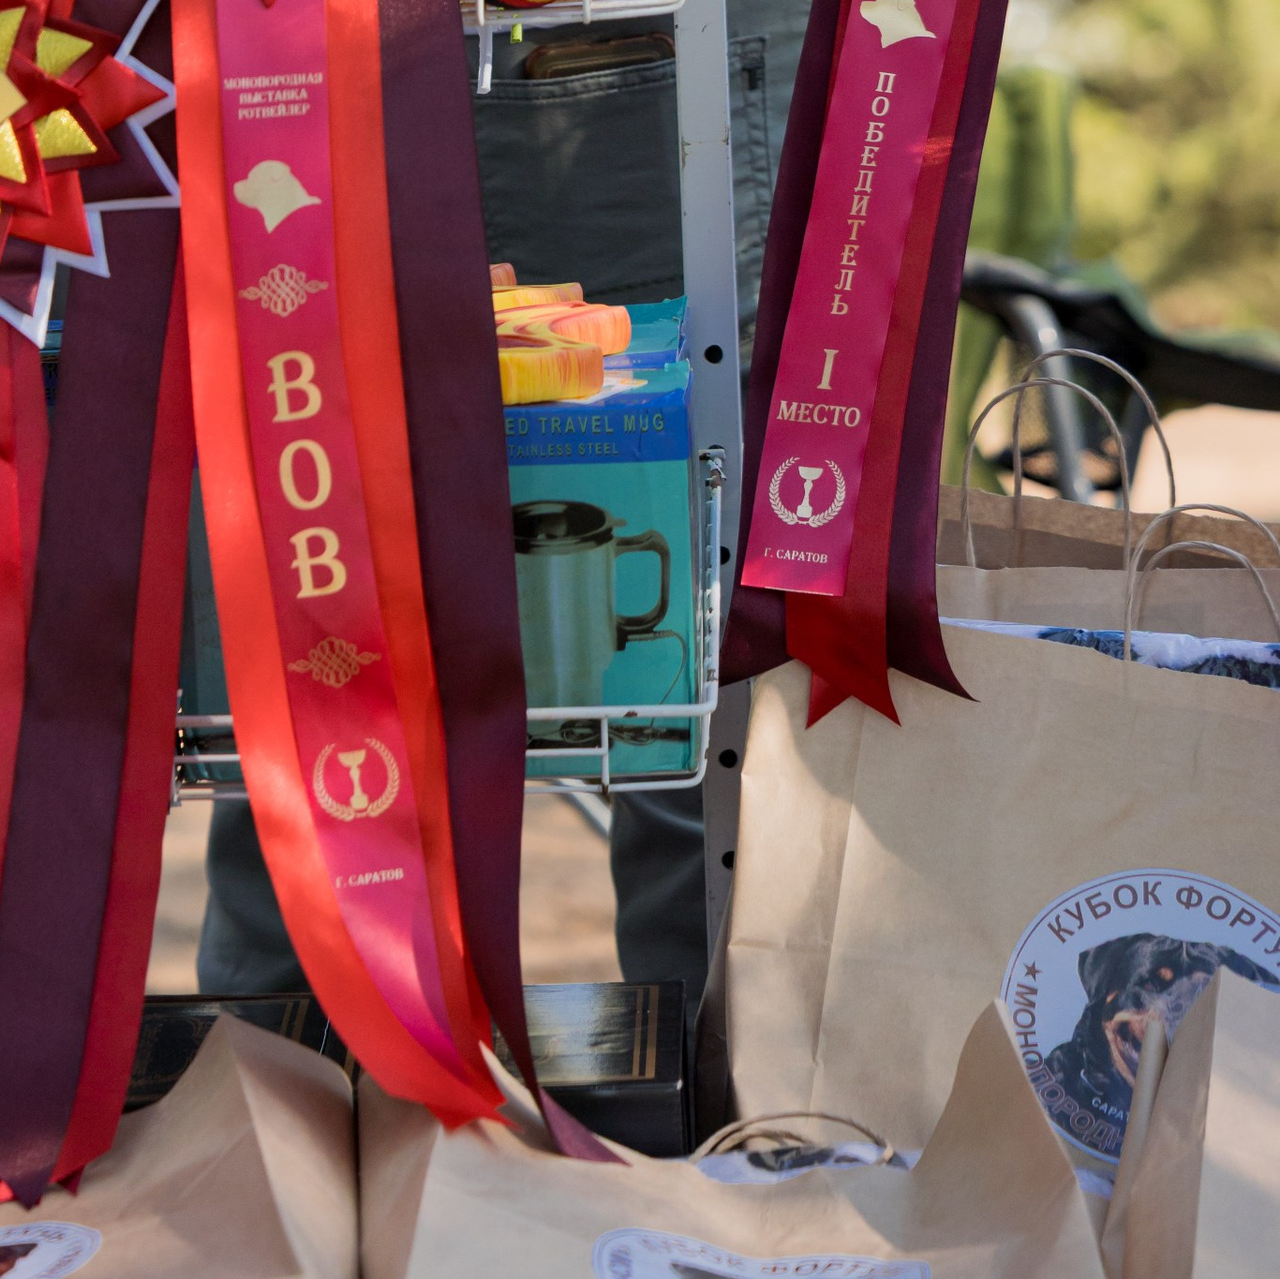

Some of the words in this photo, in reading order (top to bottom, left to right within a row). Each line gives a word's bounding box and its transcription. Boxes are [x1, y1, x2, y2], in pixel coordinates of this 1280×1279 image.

[830, 71, 896, 316] ПОБЕДИТЕЛЬ
[505, 417, 529, 436] ED
[539, 415, 614, 435] TRAVEL
[623, 413, 665, 433] MUG
[776, 400, 861, 428] МЕСТО
[508, 443, 572, 458] TAINLESS
[578, 442, 620, 456] STEEL
[266, 350, 348, 599] BOB
[776, 549, 828, 564] САРАТОВ
[348, 868, 404, 887] САРАТОВ
[1047, 881, 1163, 944] КУБОК
[1175, 885, 1280, 967] ФОРТ
[1013, 983, 1121, 1151] МОНОПОРОД
[1091, 1096, 1130, 1122] САРАТ
